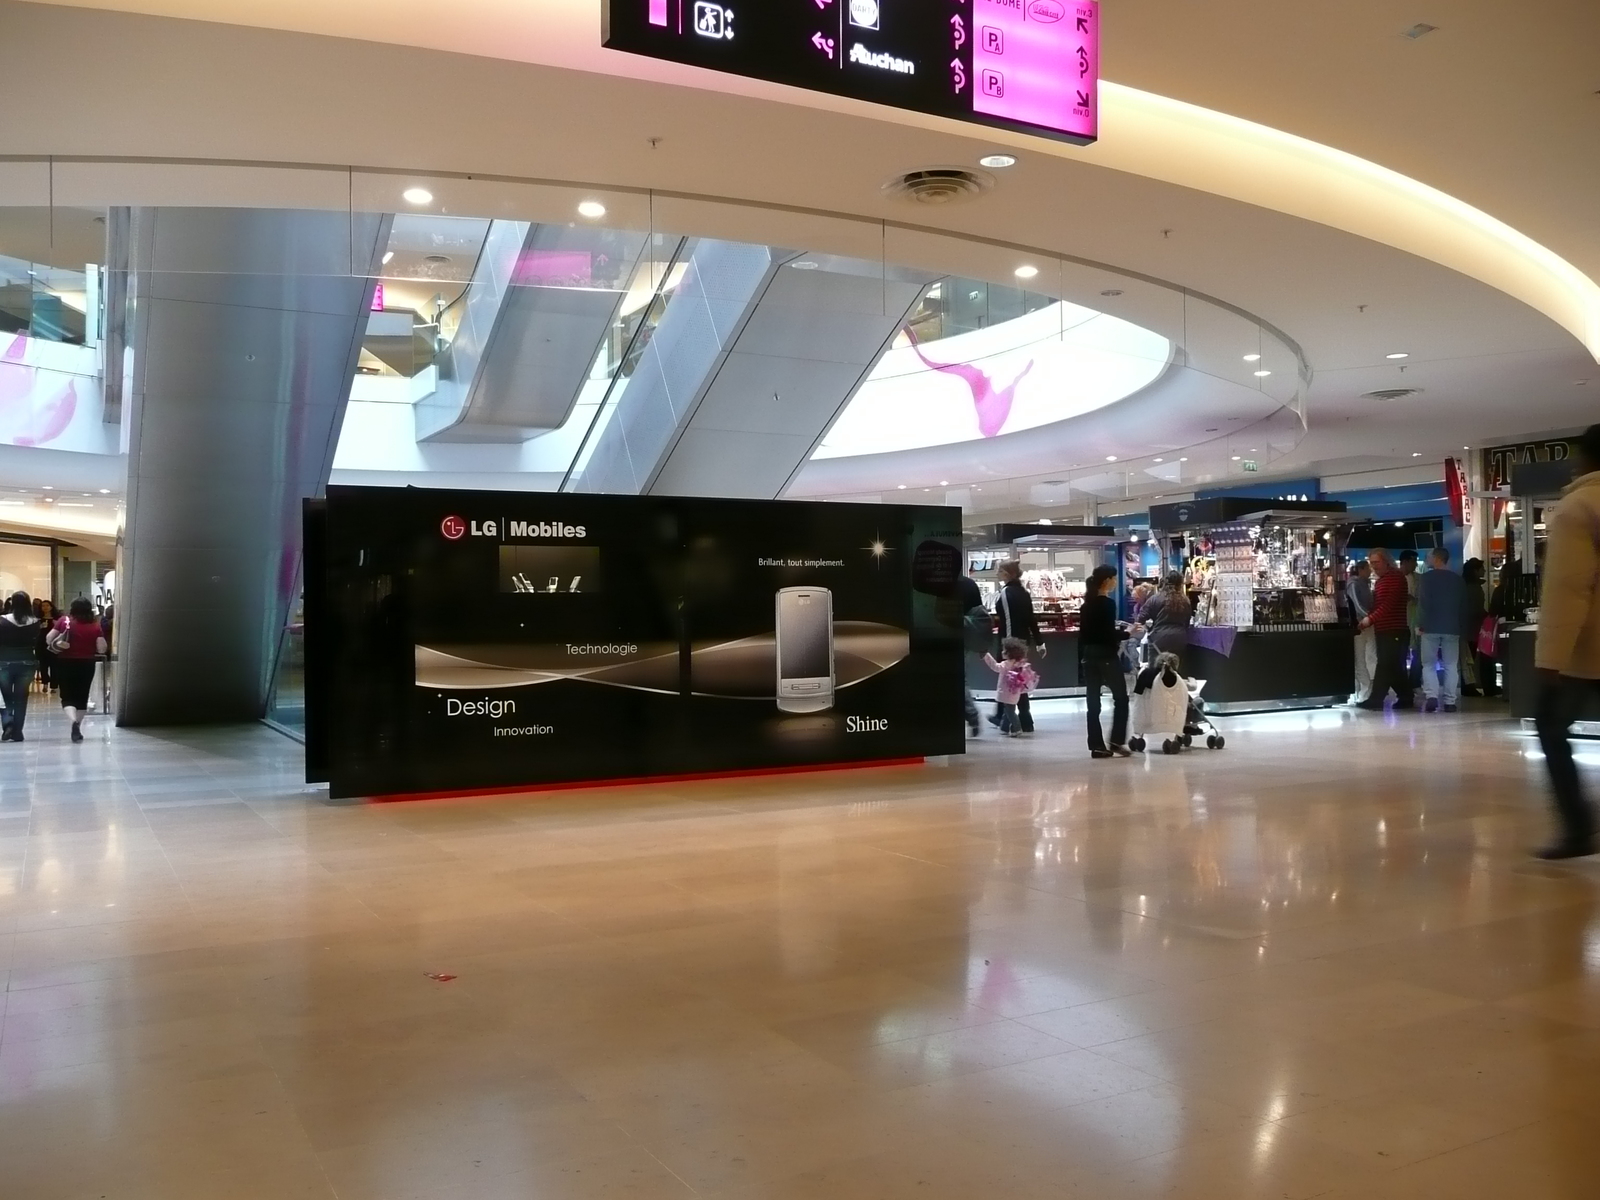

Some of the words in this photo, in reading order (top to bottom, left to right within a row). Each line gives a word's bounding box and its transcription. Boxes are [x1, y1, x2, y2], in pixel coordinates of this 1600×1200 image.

[849, 42, 915, 75] Auchan
[1455, 458, 1471, 523] TABAC
[470, 520, 497, 536] LG
[510, 520, 587, 538] Mobiles
[758, 557, 786, 568] Brillant,
[787, 558, 803, 567] tout
[804, 558, 845, 569] simplement.
[565, 642, 638, 656] Technologie
[446, 696, 516, 719] Design
[493, 724, 554, 737] Innovation
[846, 715, 889, 733] Shine
